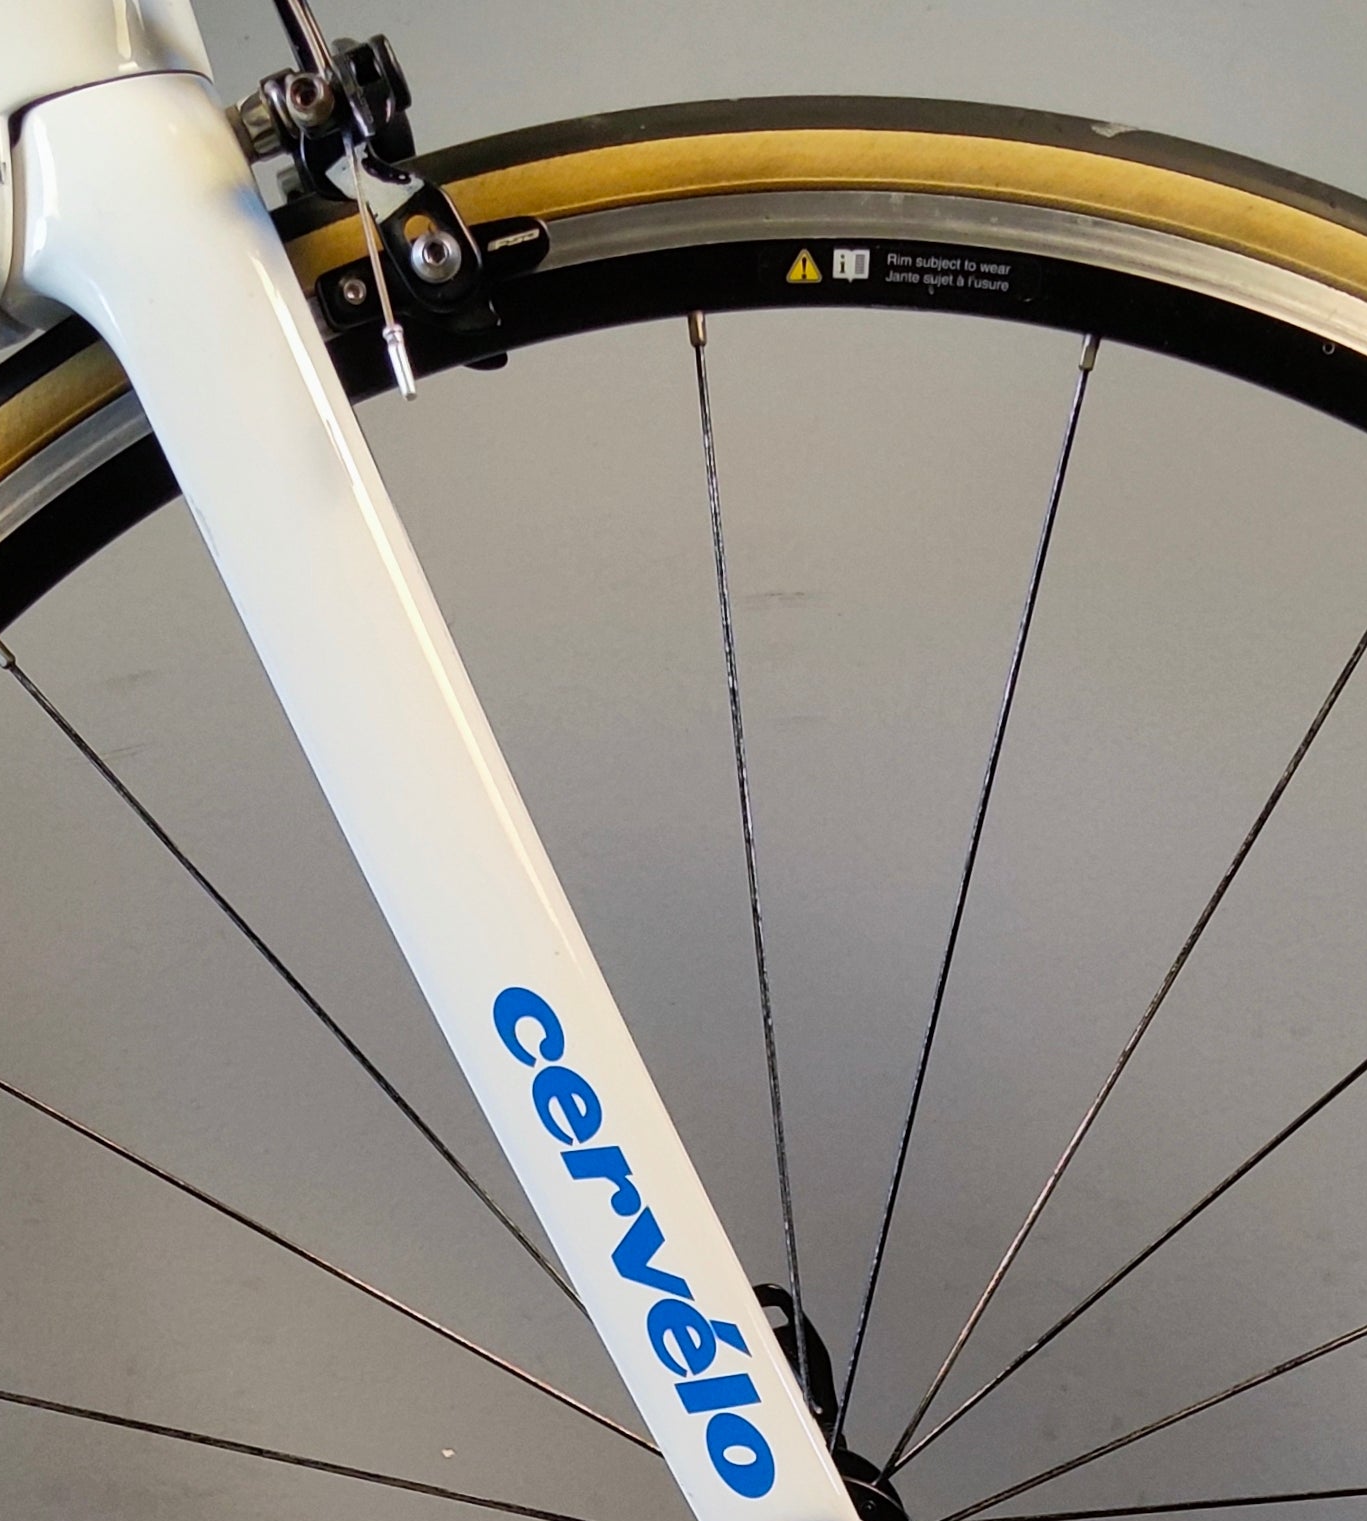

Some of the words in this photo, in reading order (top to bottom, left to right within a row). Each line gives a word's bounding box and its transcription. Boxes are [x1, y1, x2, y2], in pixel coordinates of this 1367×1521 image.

[887, 253, 912, 267] Rim
[915, 256, 961, 271] subject
[964, 260, 977, 272] to
[980, 263, 1011, 275] wear
[885, 270, 920, 284] Jante
[923, 274, 953, 288] sujet
[956, 275, 965, 287] à
[493, 986, 776, 1499] cervélo
